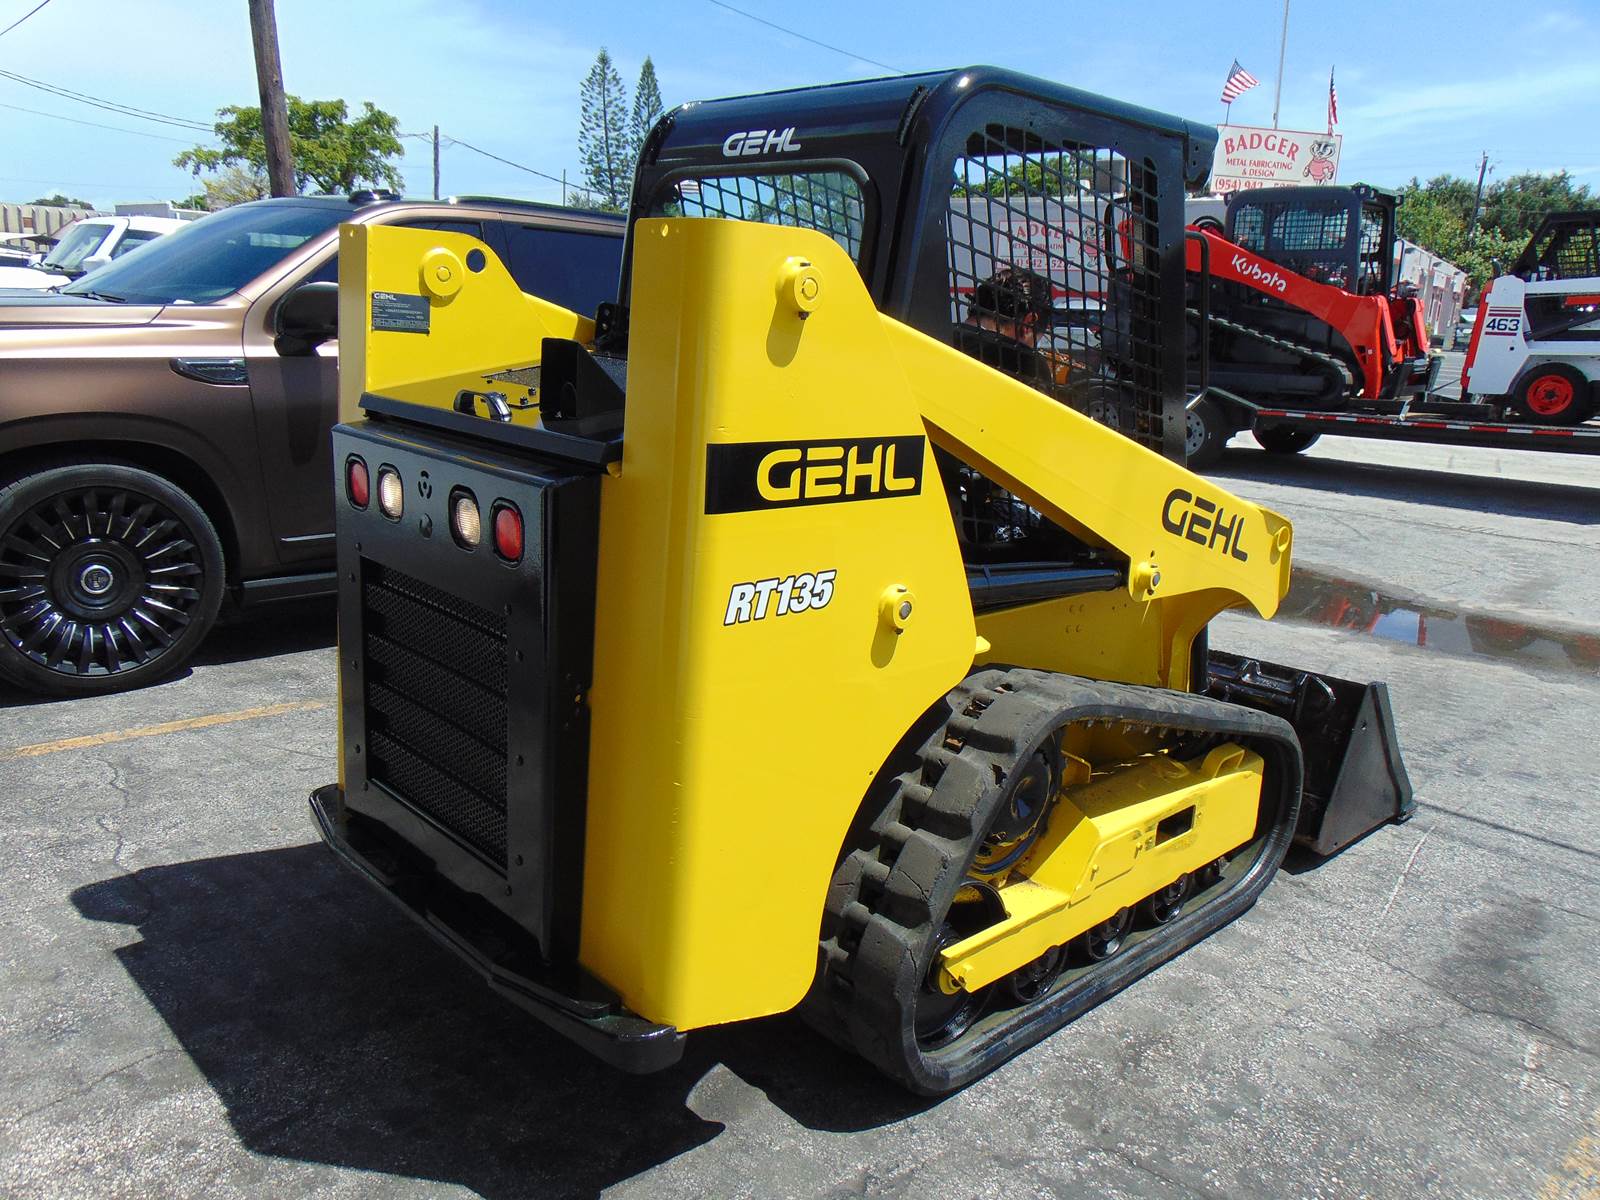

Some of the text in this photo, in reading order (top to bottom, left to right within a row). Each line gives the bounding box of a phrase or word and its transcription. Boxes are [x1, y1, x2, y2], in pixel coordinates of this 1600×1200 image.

[722, 127, 802, 157] GEHL
[1224, 132, 1299, 161] BADGER
[1226, 158, 1293, 170] METAL FABRICATING
[1241, 168, 1274, 177] & DESIGN
[1215, 179, 1242, 190] (954)
[1008, 223, 1075, 243] ADGER
[1231, 254, 1287, 292] Kubota
[1486, 318, 1520, 331] 463
[756, 443, 916, 502] GEHL
[1162, 488, 1248, 562] GEHL
[723, 569, 837, 626] RT135
